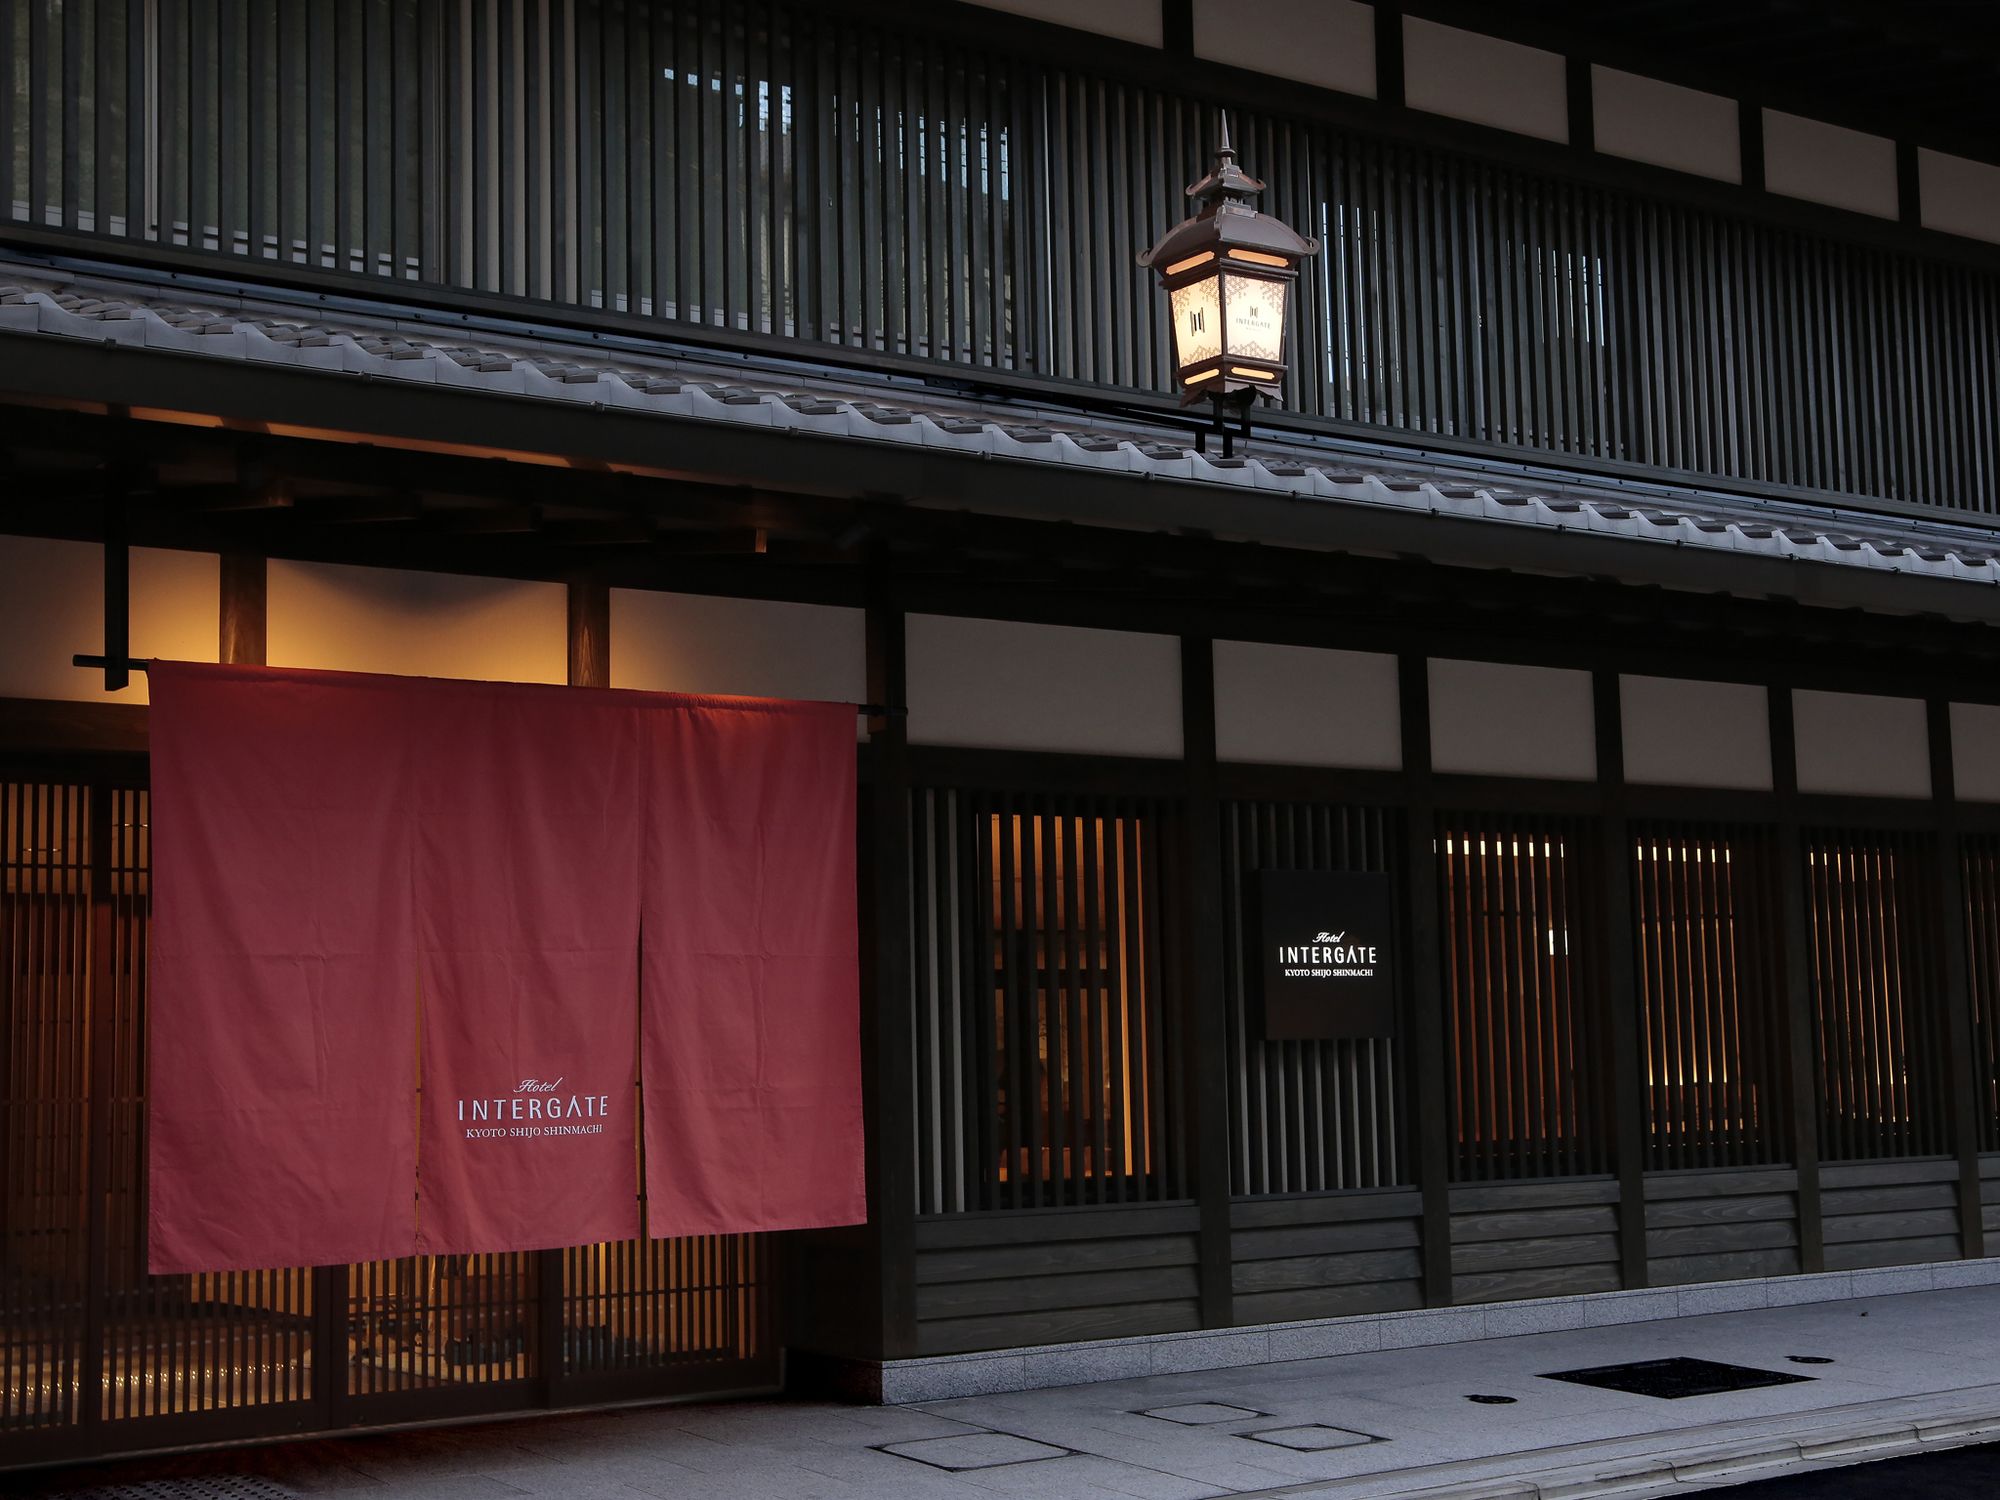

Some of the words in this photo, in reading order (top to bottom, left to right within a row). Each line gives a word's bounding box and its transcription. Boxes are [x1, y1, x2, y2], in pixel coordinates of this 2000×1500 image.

[1235, 318, 1271, 328] INTERGATE
[1312, 931, 1345, 943] Hotel
[1279, 945, 1377, 964] INTERGATE
[1284, 969, 1310, 977] KYOTO
[1311, 969, 1332, 978] SHIJO
[1332, 969, 1373, 977] SHINMACHI
[513, 1077, 563, 1093] Hotel
[458, 1095, 608, 1121] INTERGATE
[466, 1128, 506, 1138] KYOTO
[509, 1127, 541, 1139] SHIJO
[543, 1124, 603, 1136] SHINMACHI
